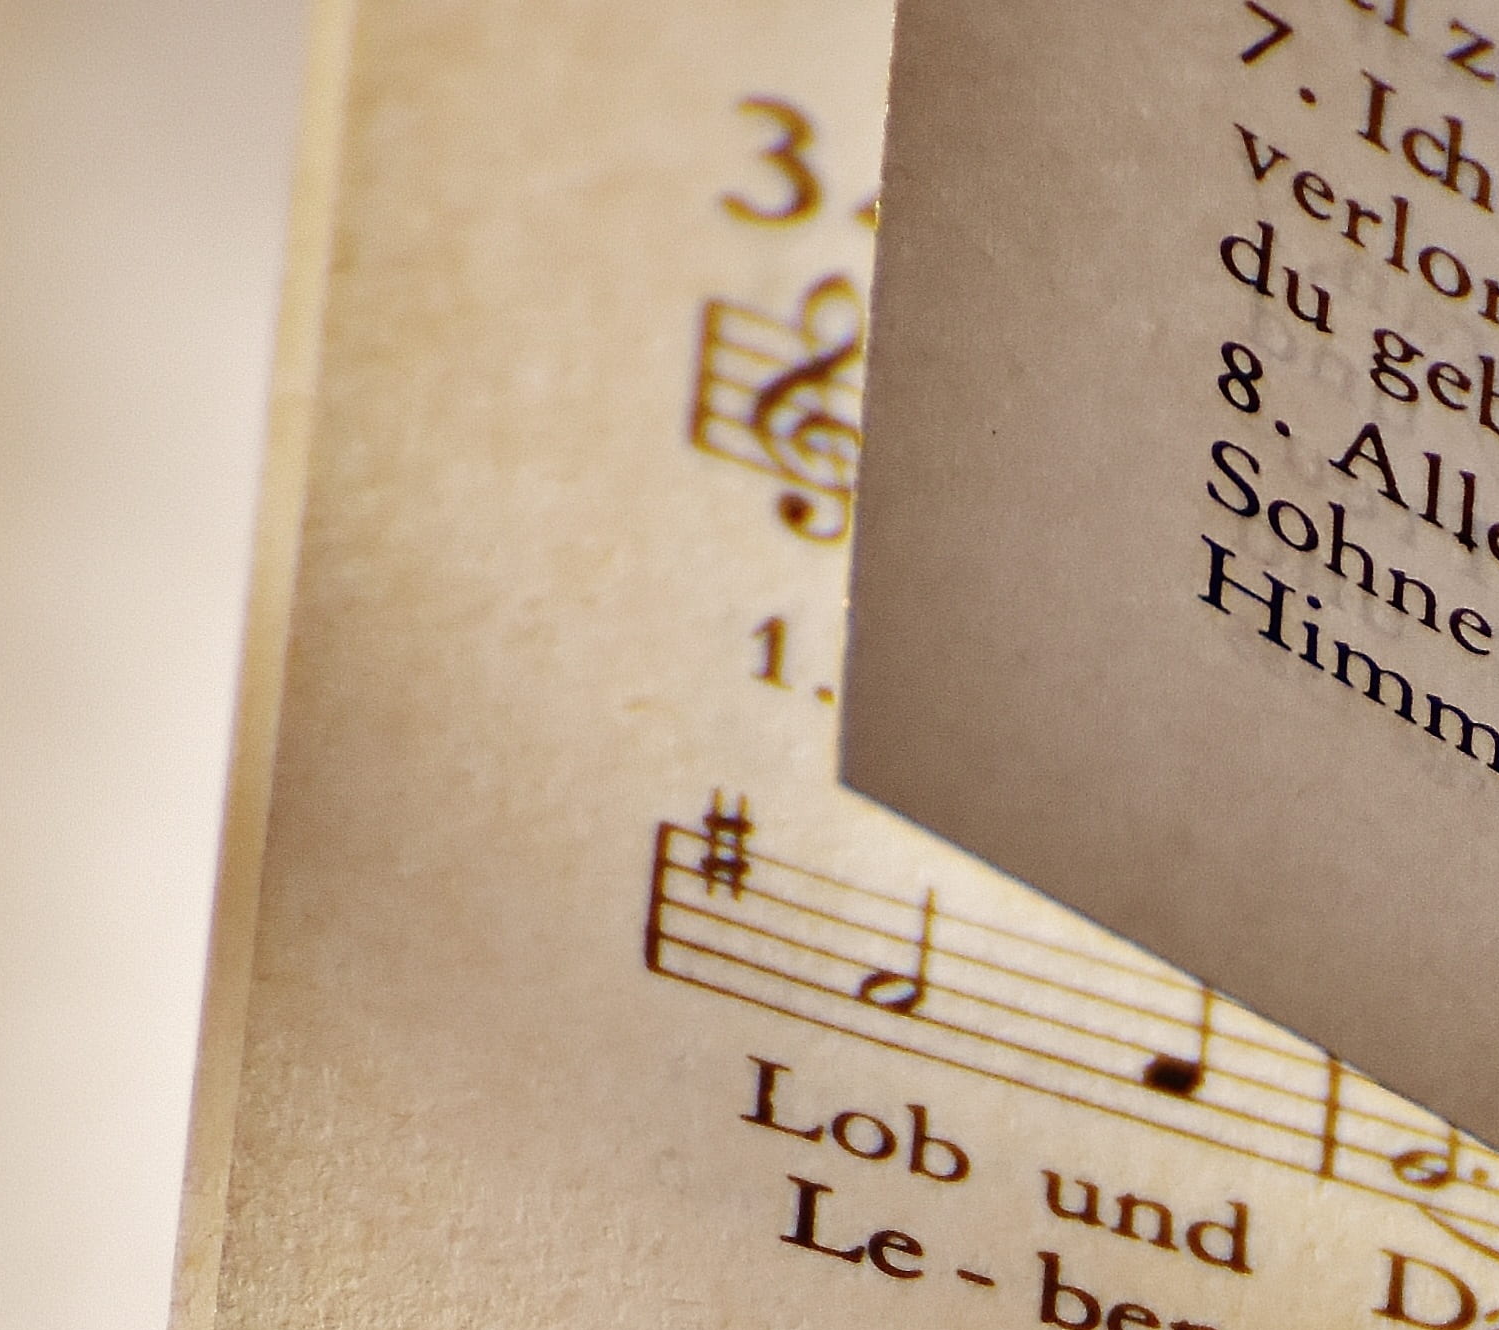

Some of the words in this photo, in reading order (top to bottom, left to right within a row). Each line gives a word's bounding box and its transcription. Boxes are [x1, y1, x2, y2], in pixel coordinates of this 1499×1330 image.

[720, 97, 876, 228] 3
[1357, 69, 1496, 212] Ich
[1218, 221, 1334, 334] du
[1217, 340, 1292, 438] 8.
[1205, 440, 1494, 656] Sohne
[741, 1053, 973, 1182] Lob
[1039, 1167, 1255, 1276] und
